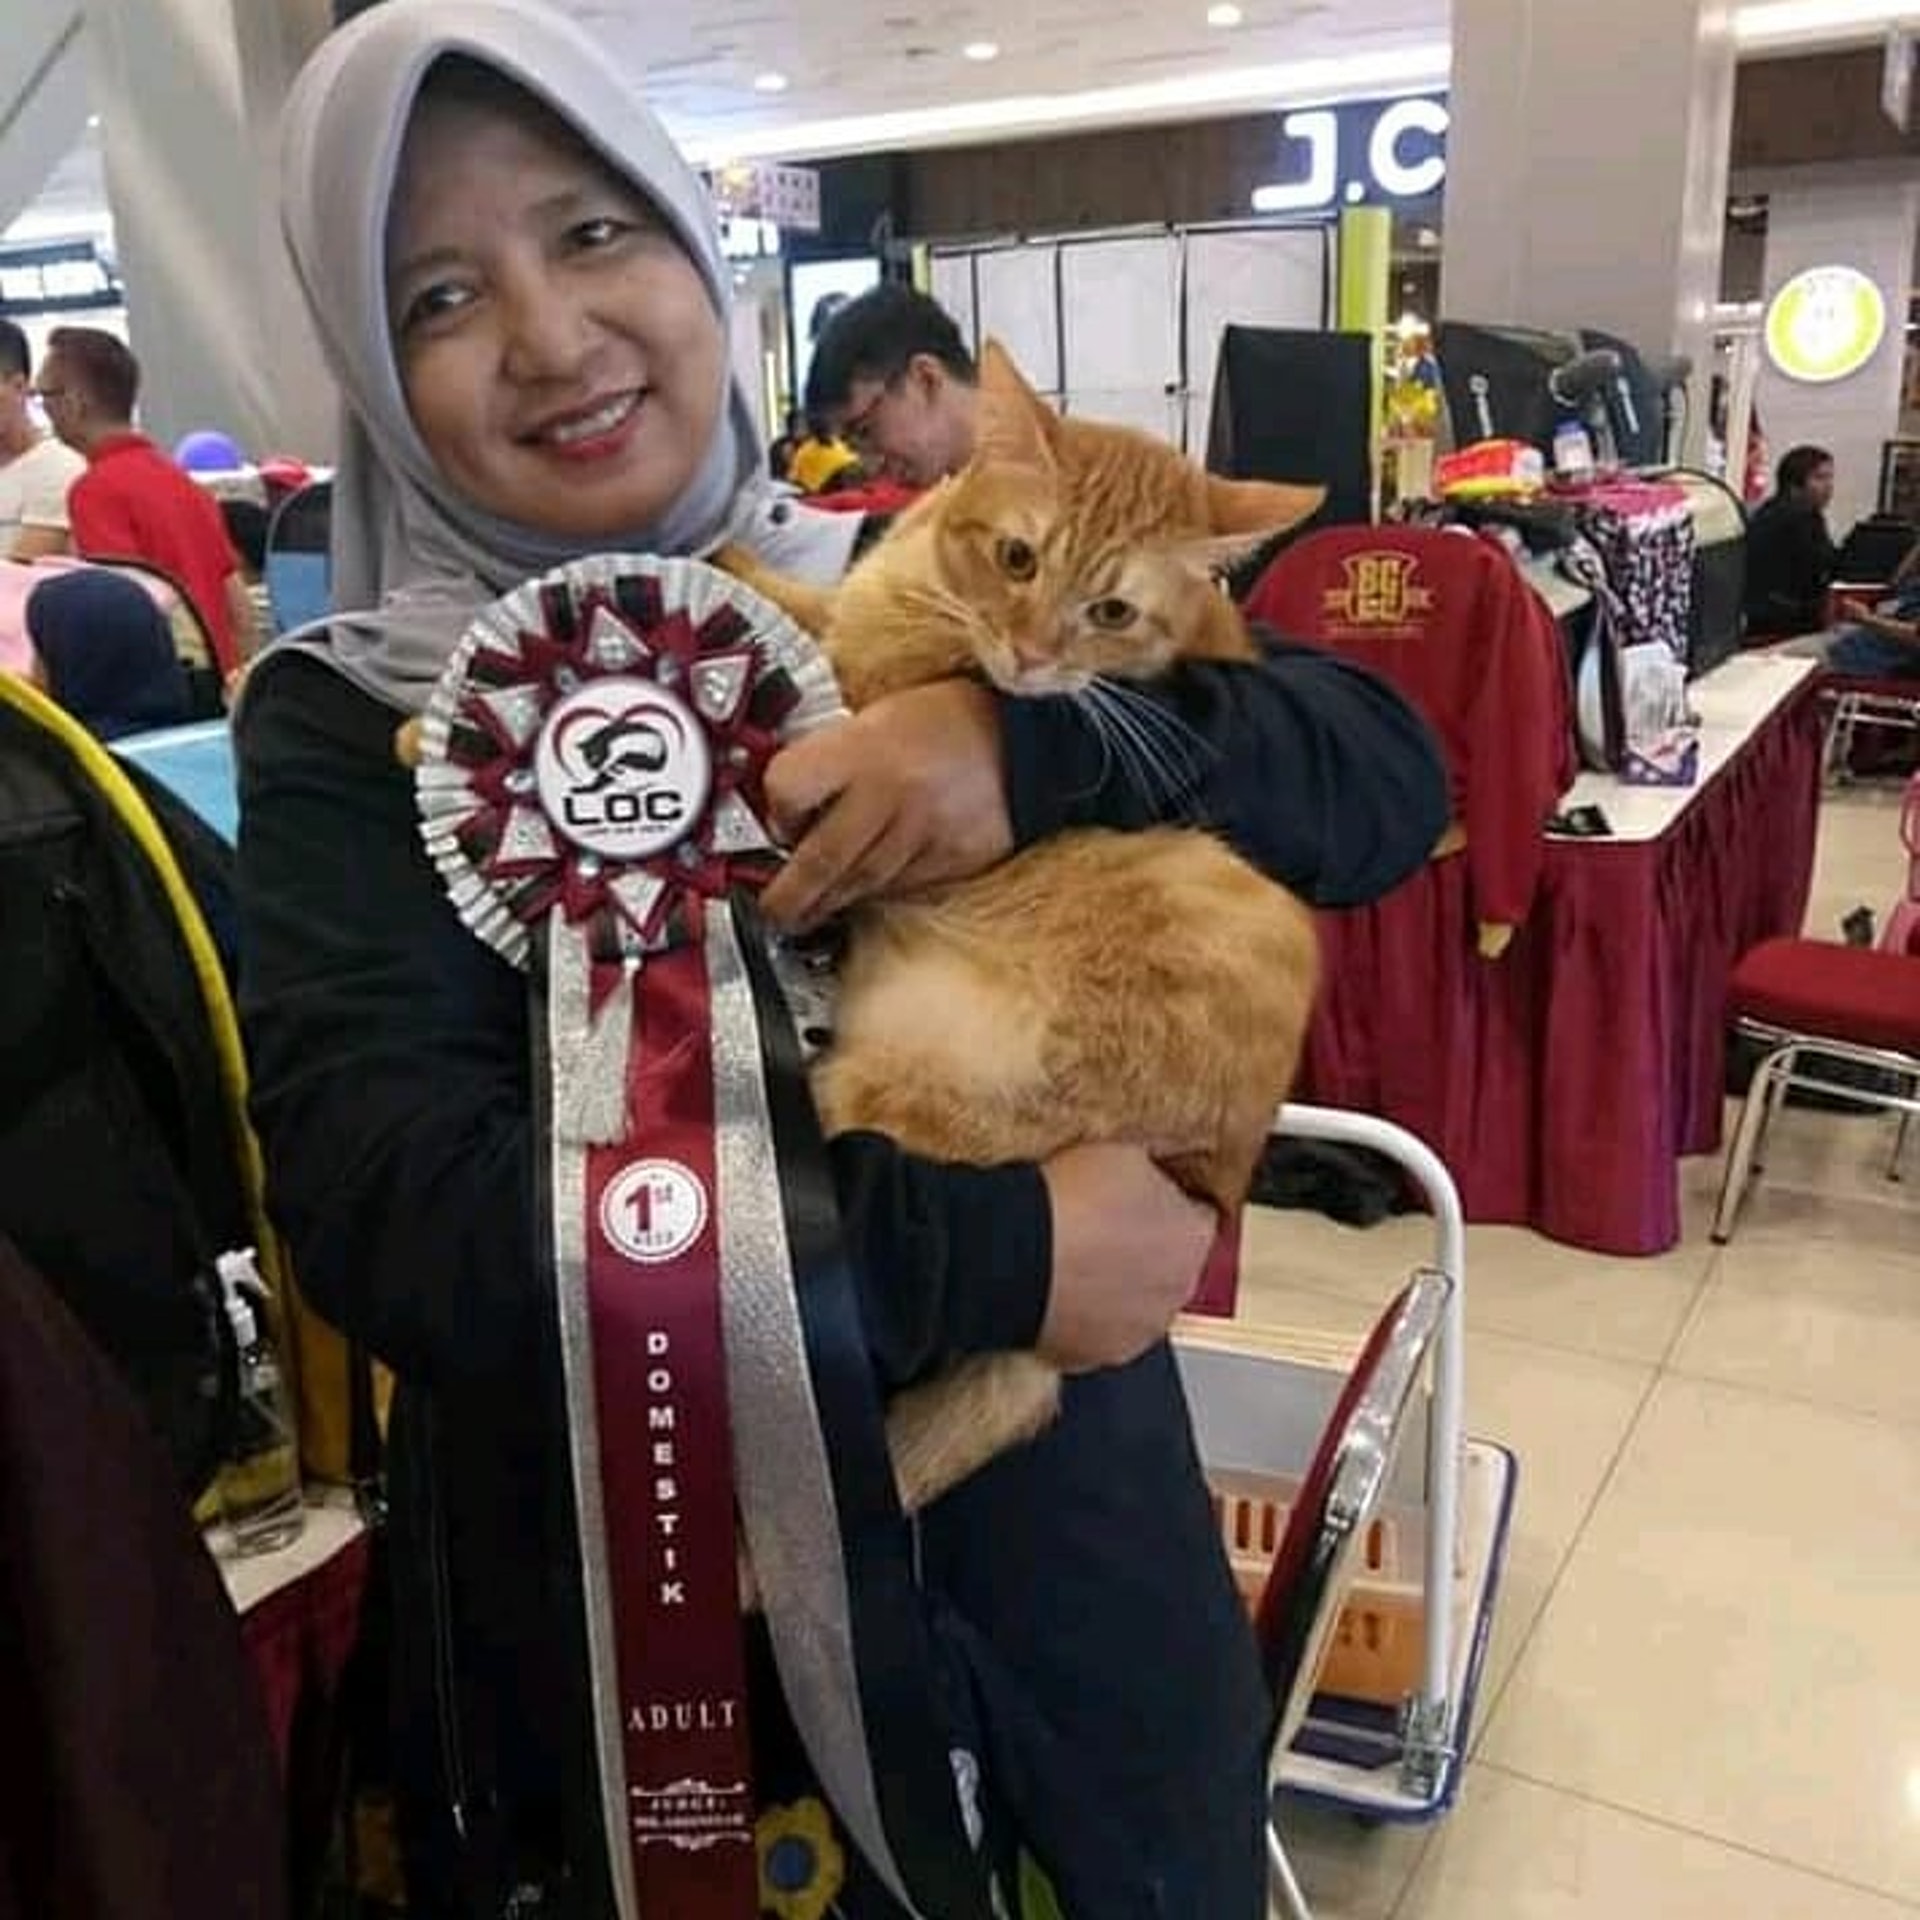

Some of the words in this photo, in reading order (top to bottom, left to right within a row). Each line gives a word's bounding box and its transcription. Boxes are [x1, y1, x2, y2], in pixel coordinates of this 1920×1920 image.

[563, 791, 682, 825] LOC
[647, 1331, 684, 1604] DOMESTIK
[627, 1702, 735, 1731] ADULT
